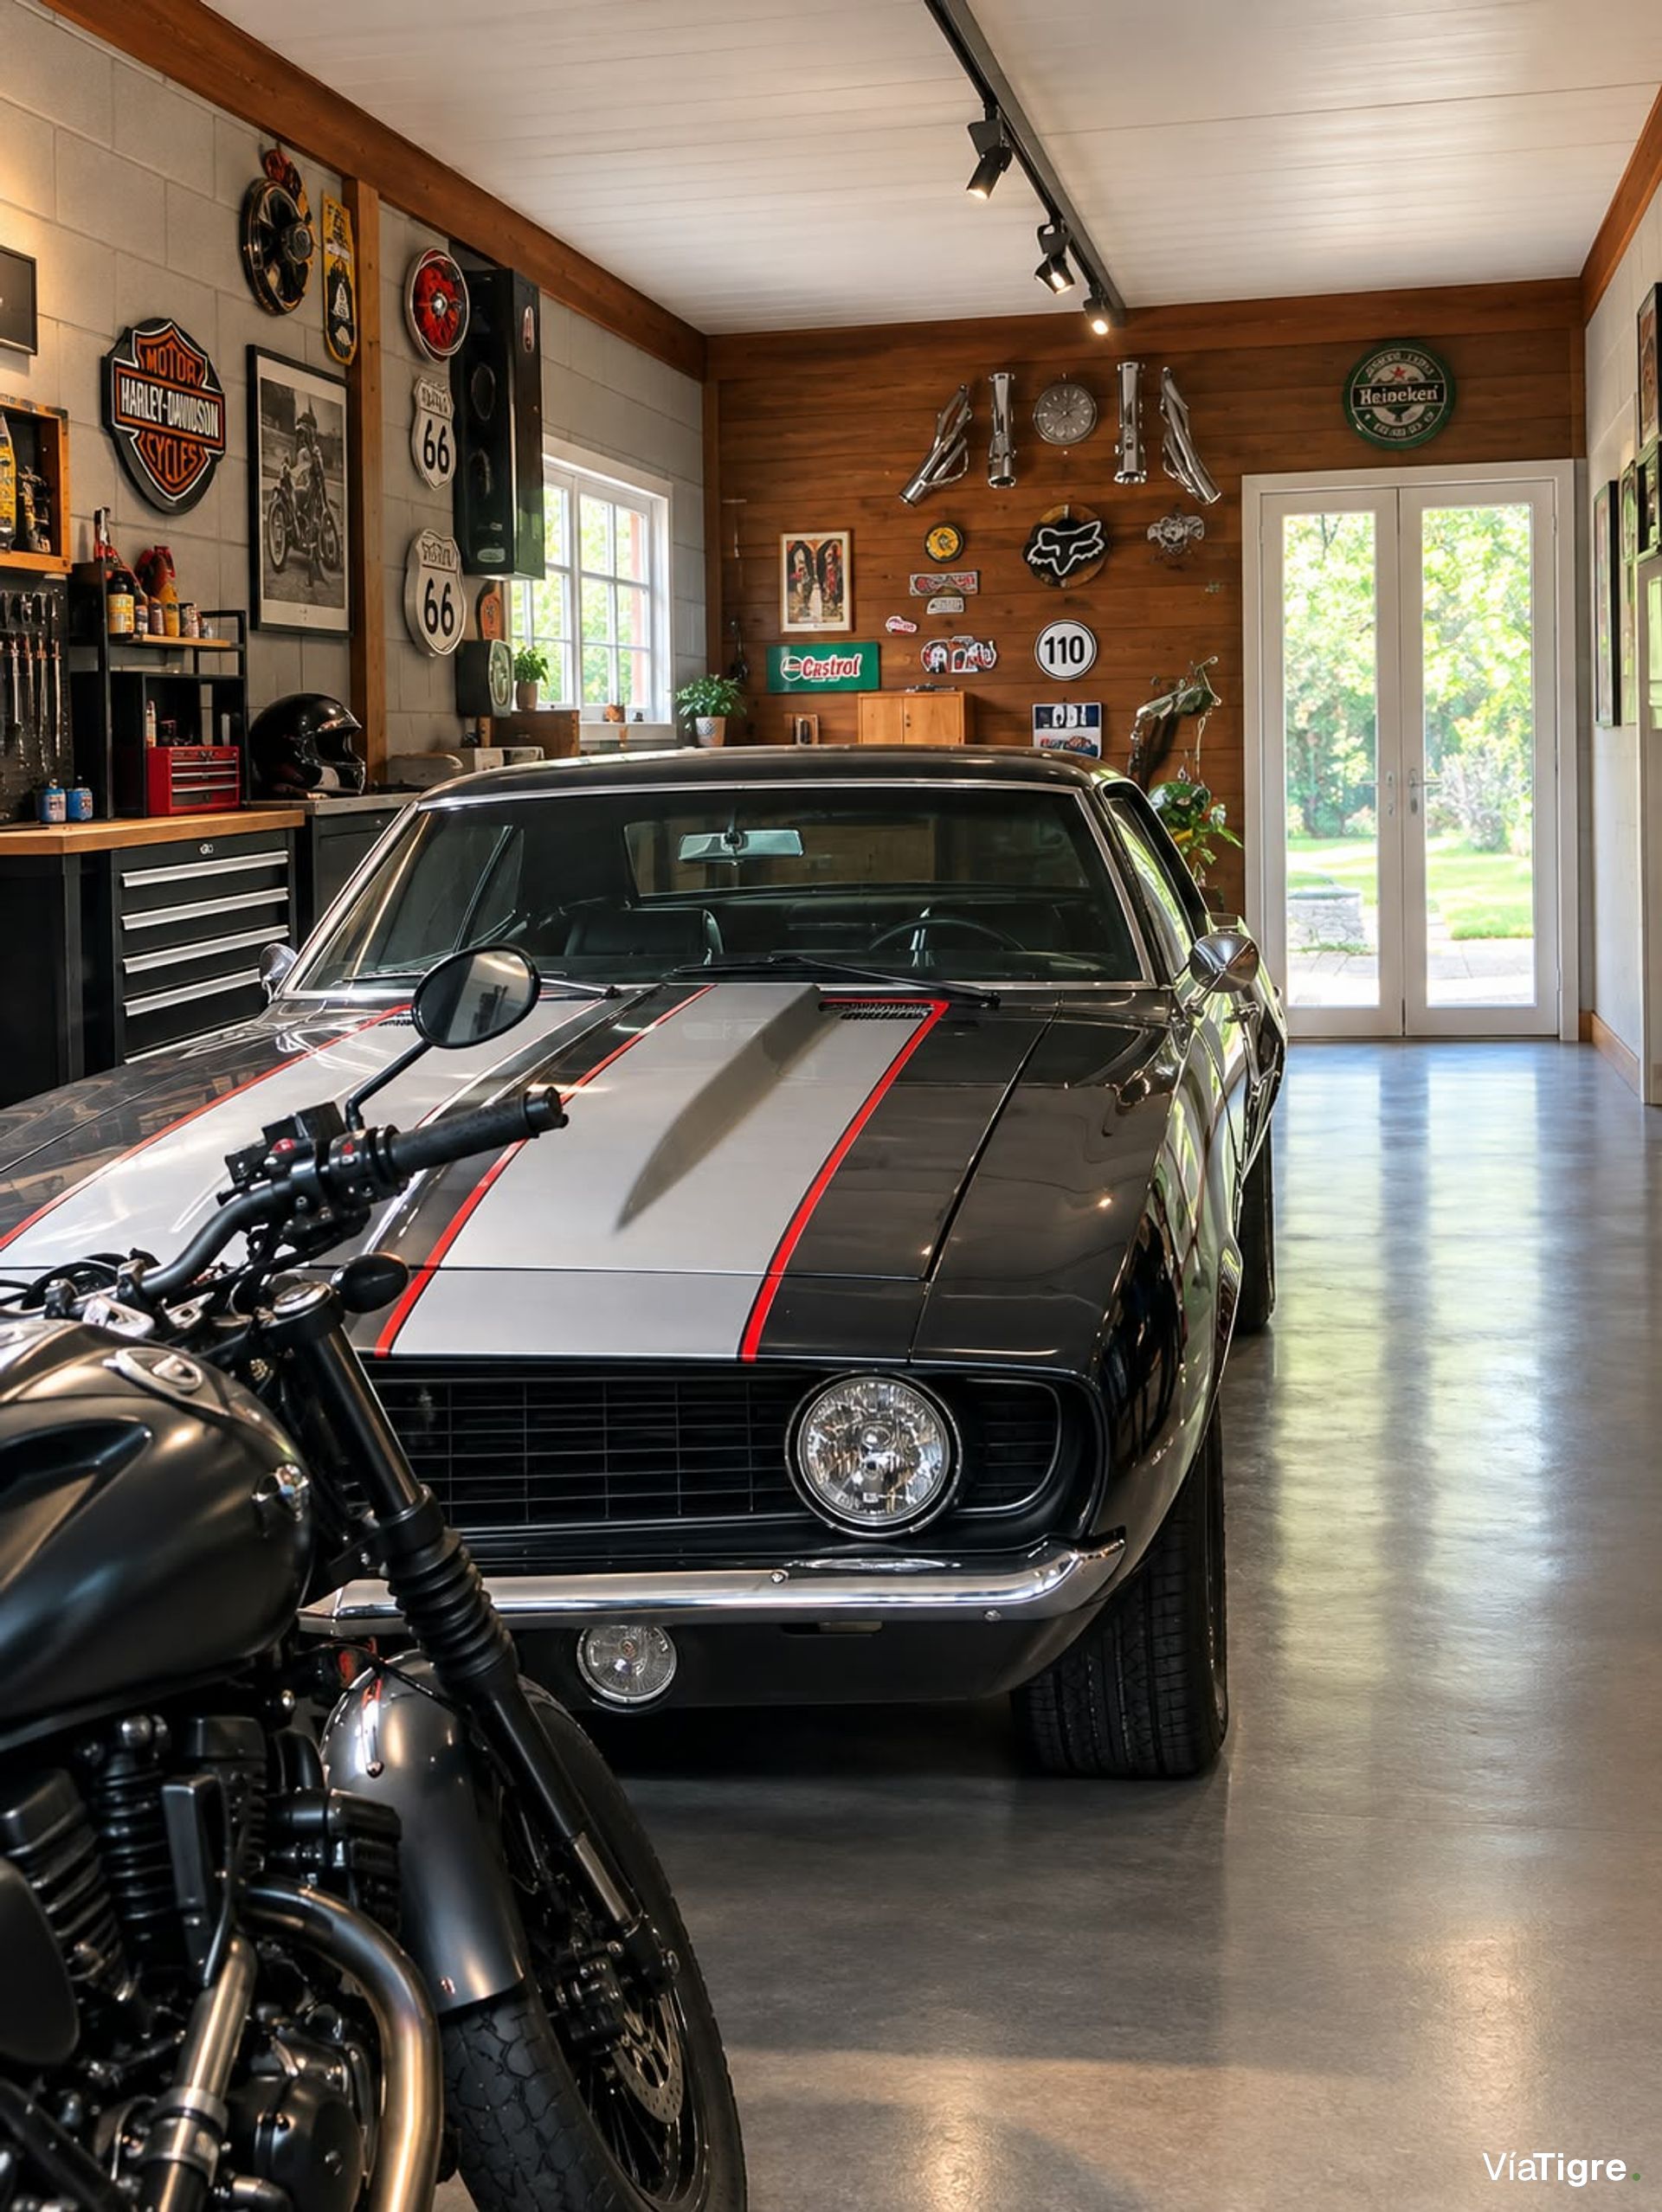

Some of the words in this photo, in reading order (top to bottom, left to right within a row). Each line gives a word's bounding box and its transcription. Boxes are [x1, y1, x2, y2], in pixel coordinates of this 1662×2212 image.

[146, 342, 197, 386] MOTOR
[146, 432, 198, 483] CYCLES
[423, 419, 449, 474] 66
[424, 576, 454, 637] 66
[1044, 635, 1085, 665] 110
